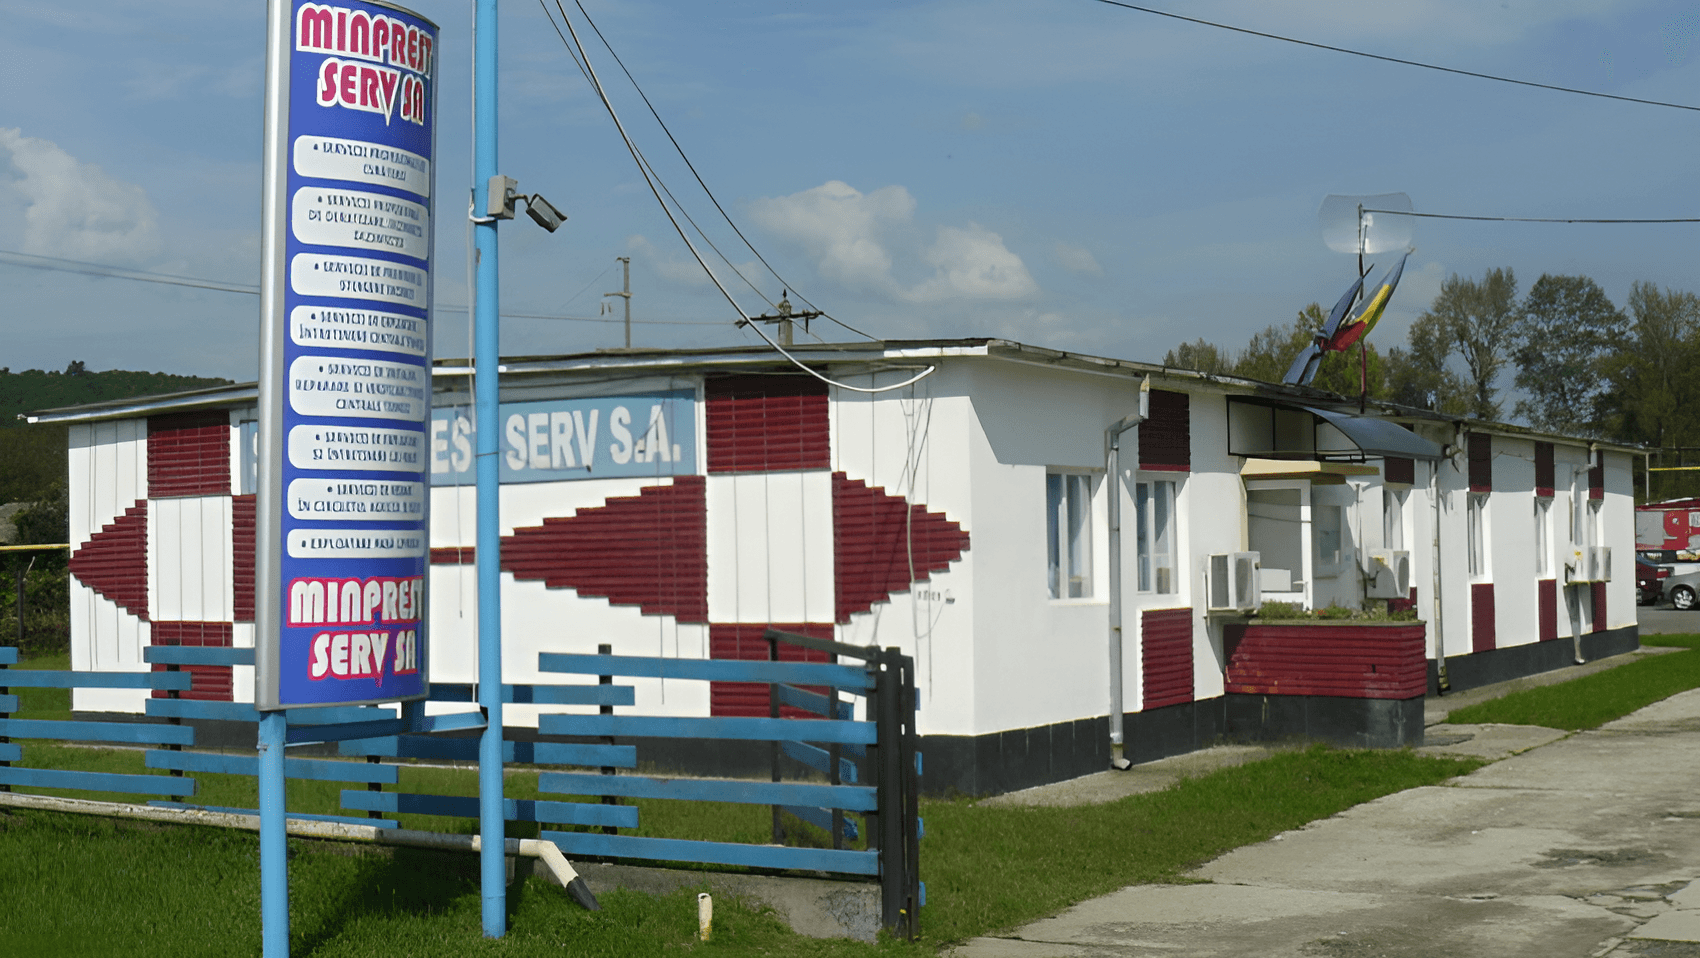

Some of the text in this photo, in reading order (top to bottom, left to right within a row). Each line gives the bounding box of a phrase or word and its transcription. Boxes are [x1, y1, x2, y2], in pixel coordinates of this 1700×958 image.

[296, 2, 433, 79] MINPREST
[317, 57, 424, 126] SERV SA
[505, 409, 599, 472] SERV
[610, 404, 681, 465] S.A.
[287, 577, 424, 627] MINPREST
[308, 630, 418, 687] SERV SA
